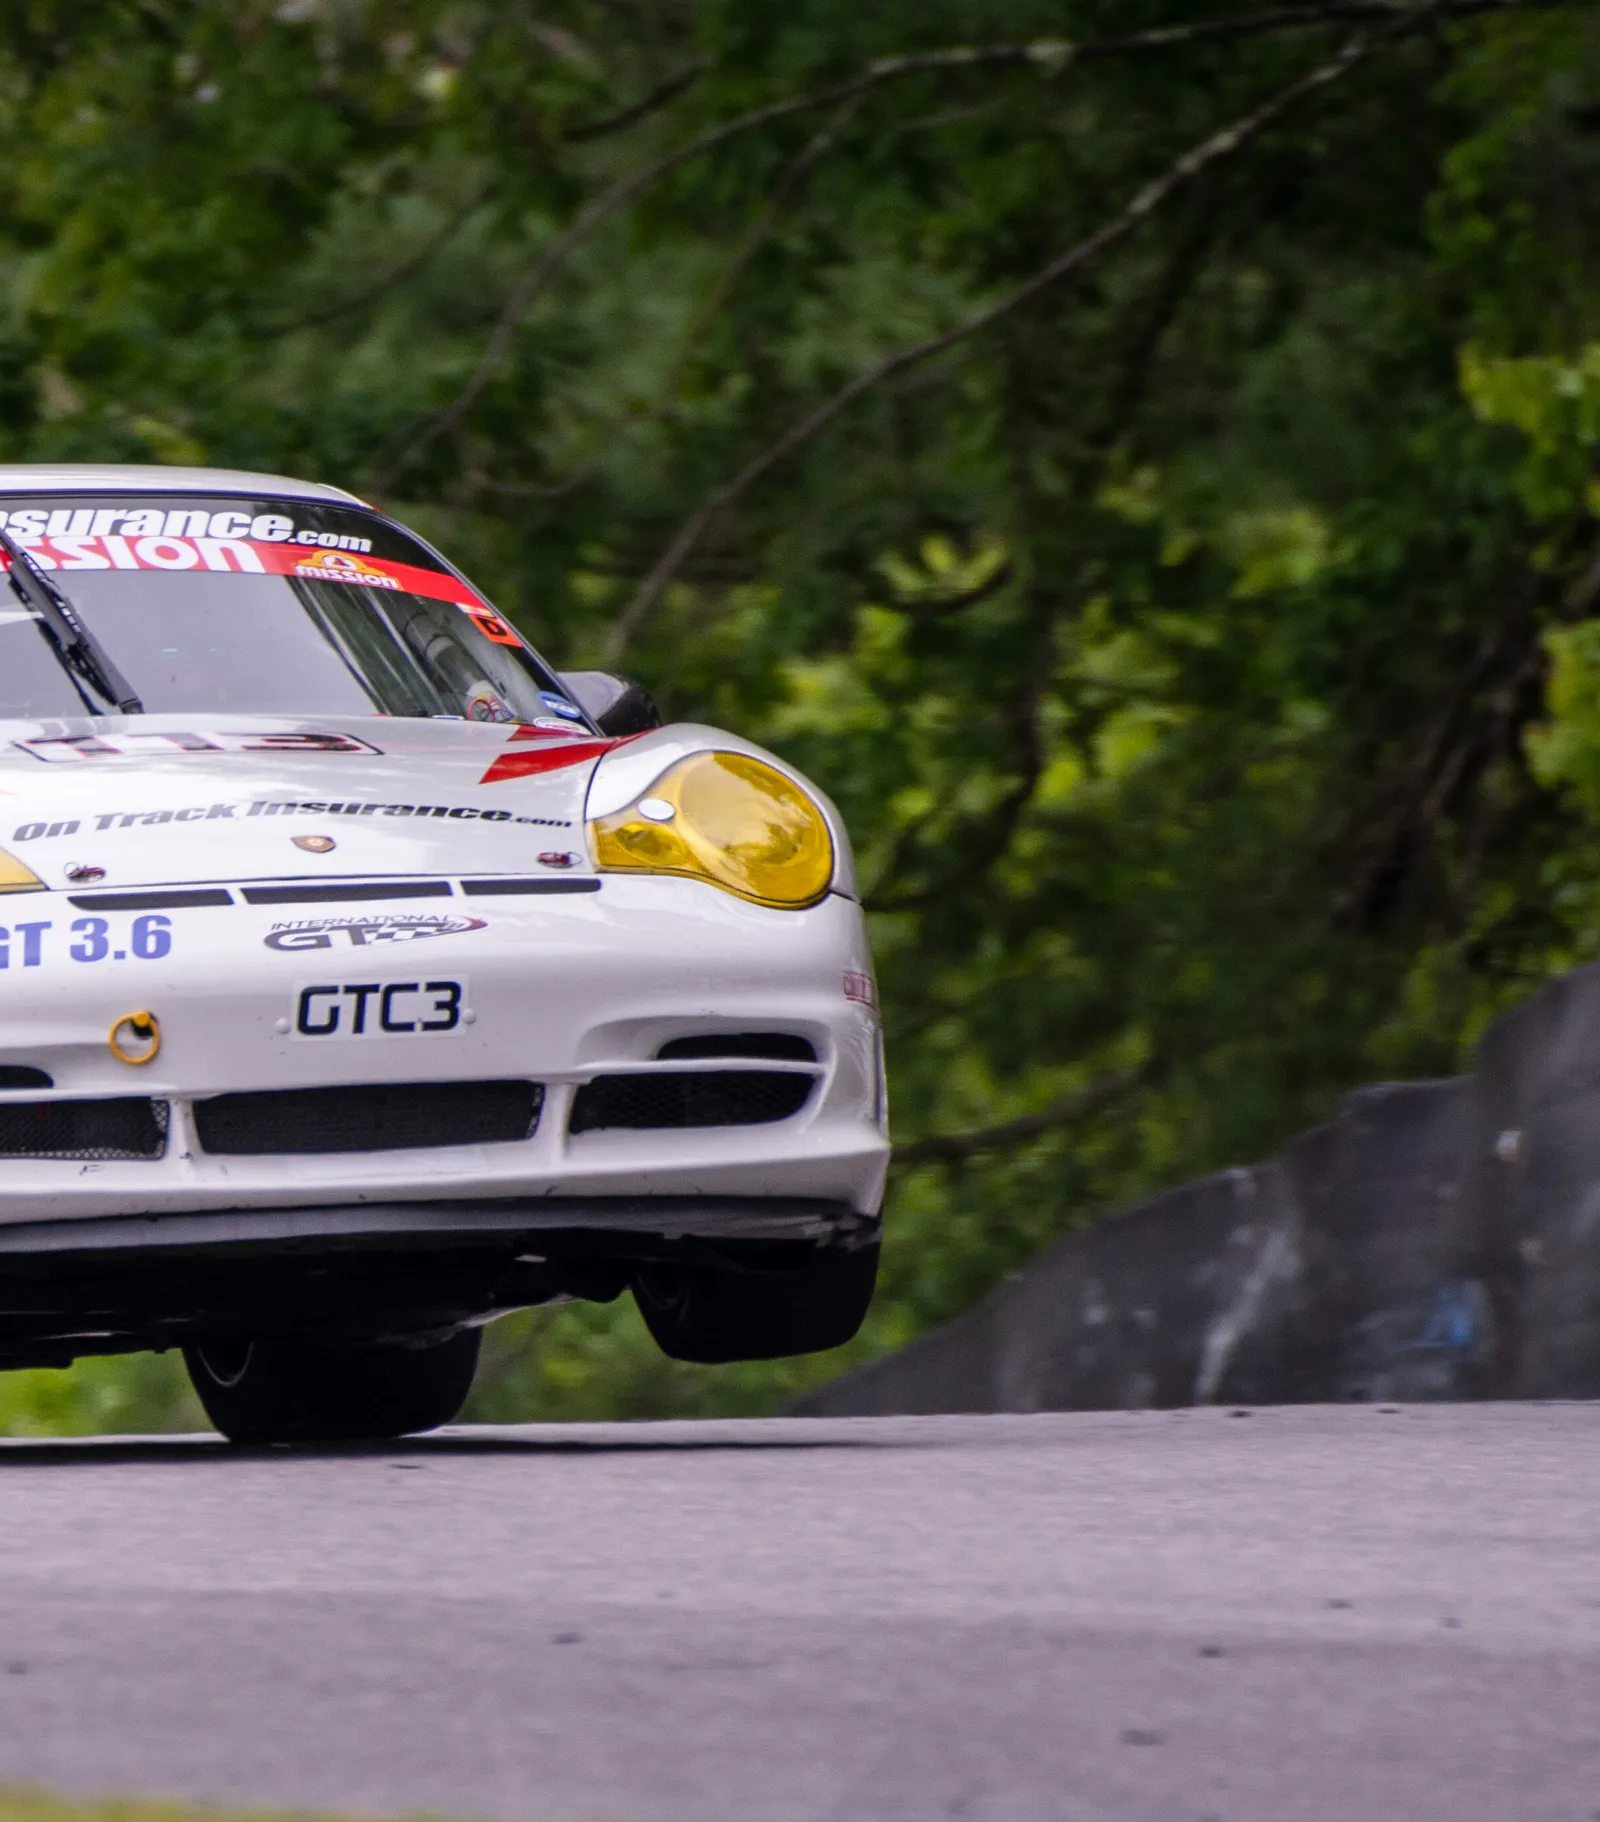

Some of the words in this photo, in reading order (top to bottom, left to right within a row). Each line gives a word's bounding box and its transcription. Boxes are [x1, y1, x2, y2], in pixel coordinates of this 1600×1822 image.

[294, 564, 400, 590] mission
[11, 819, 82, 843] On
[92, 801, 240, 833] Track
[245, 799, 573, 829] Insurance.com
[69, 914, 173, 962] 3.6
[271, 914, 451, 931] INTERNATIONAL
[297, 981, 462, 1036] GTC3
